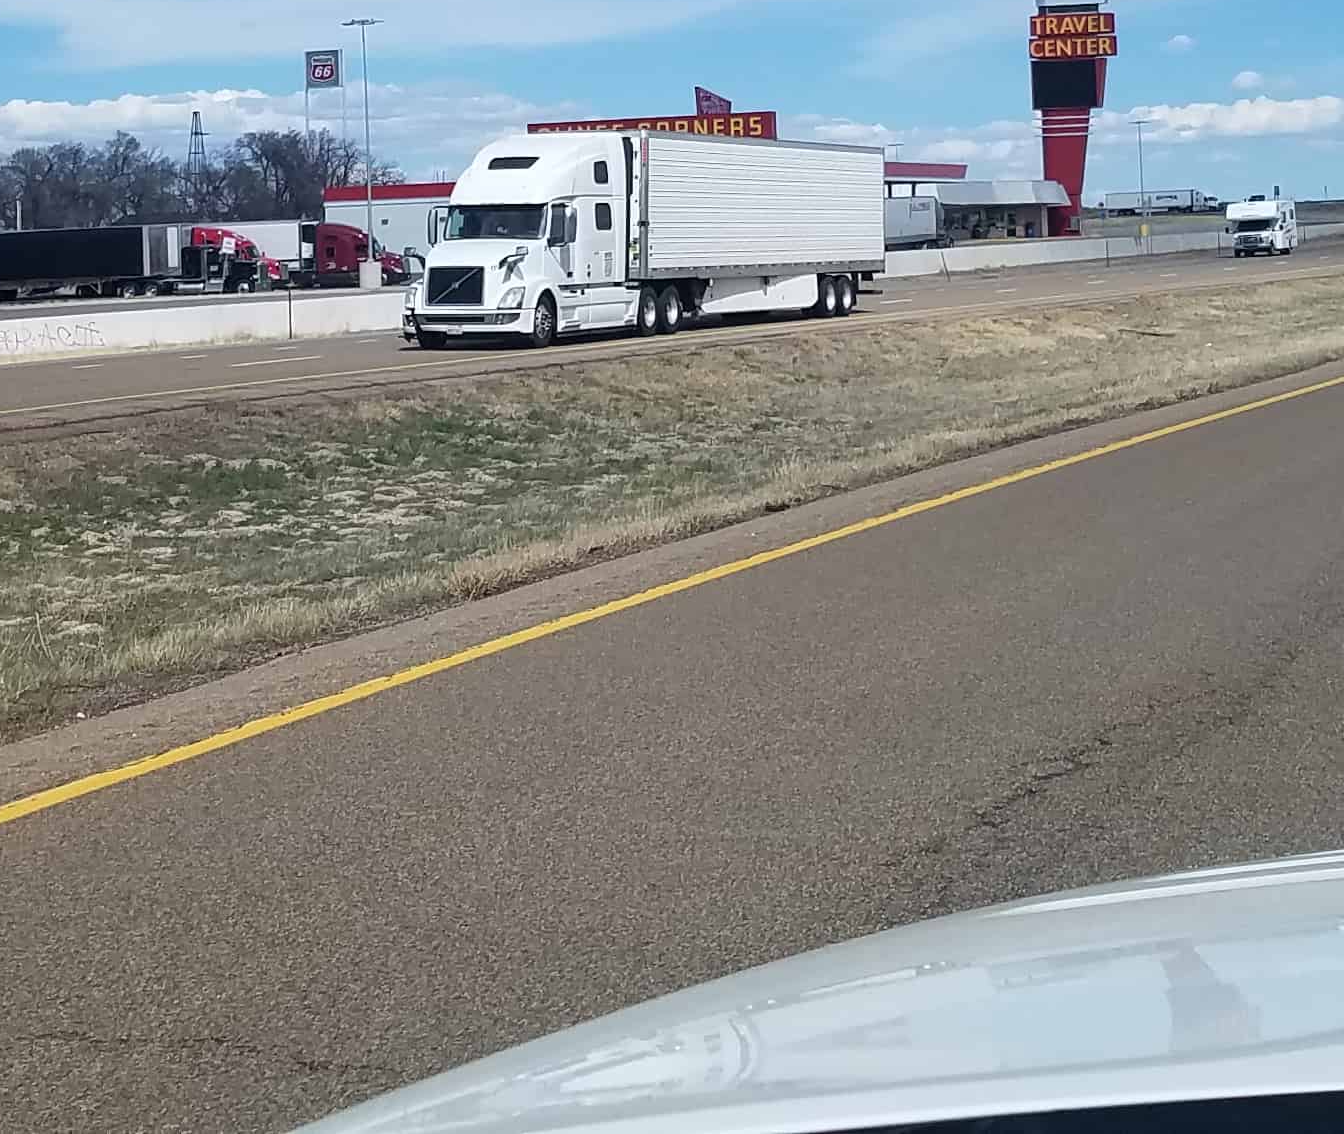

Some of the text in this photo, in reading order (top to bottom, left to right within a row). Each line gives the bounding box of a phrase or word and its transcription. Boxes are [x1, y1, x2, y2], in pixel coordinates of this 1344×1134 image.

[1032, 15, 1112, 34] TRAVEL
[1030, 37, 1112, 57] CENTER
[314, 66, 332, 78] 66
